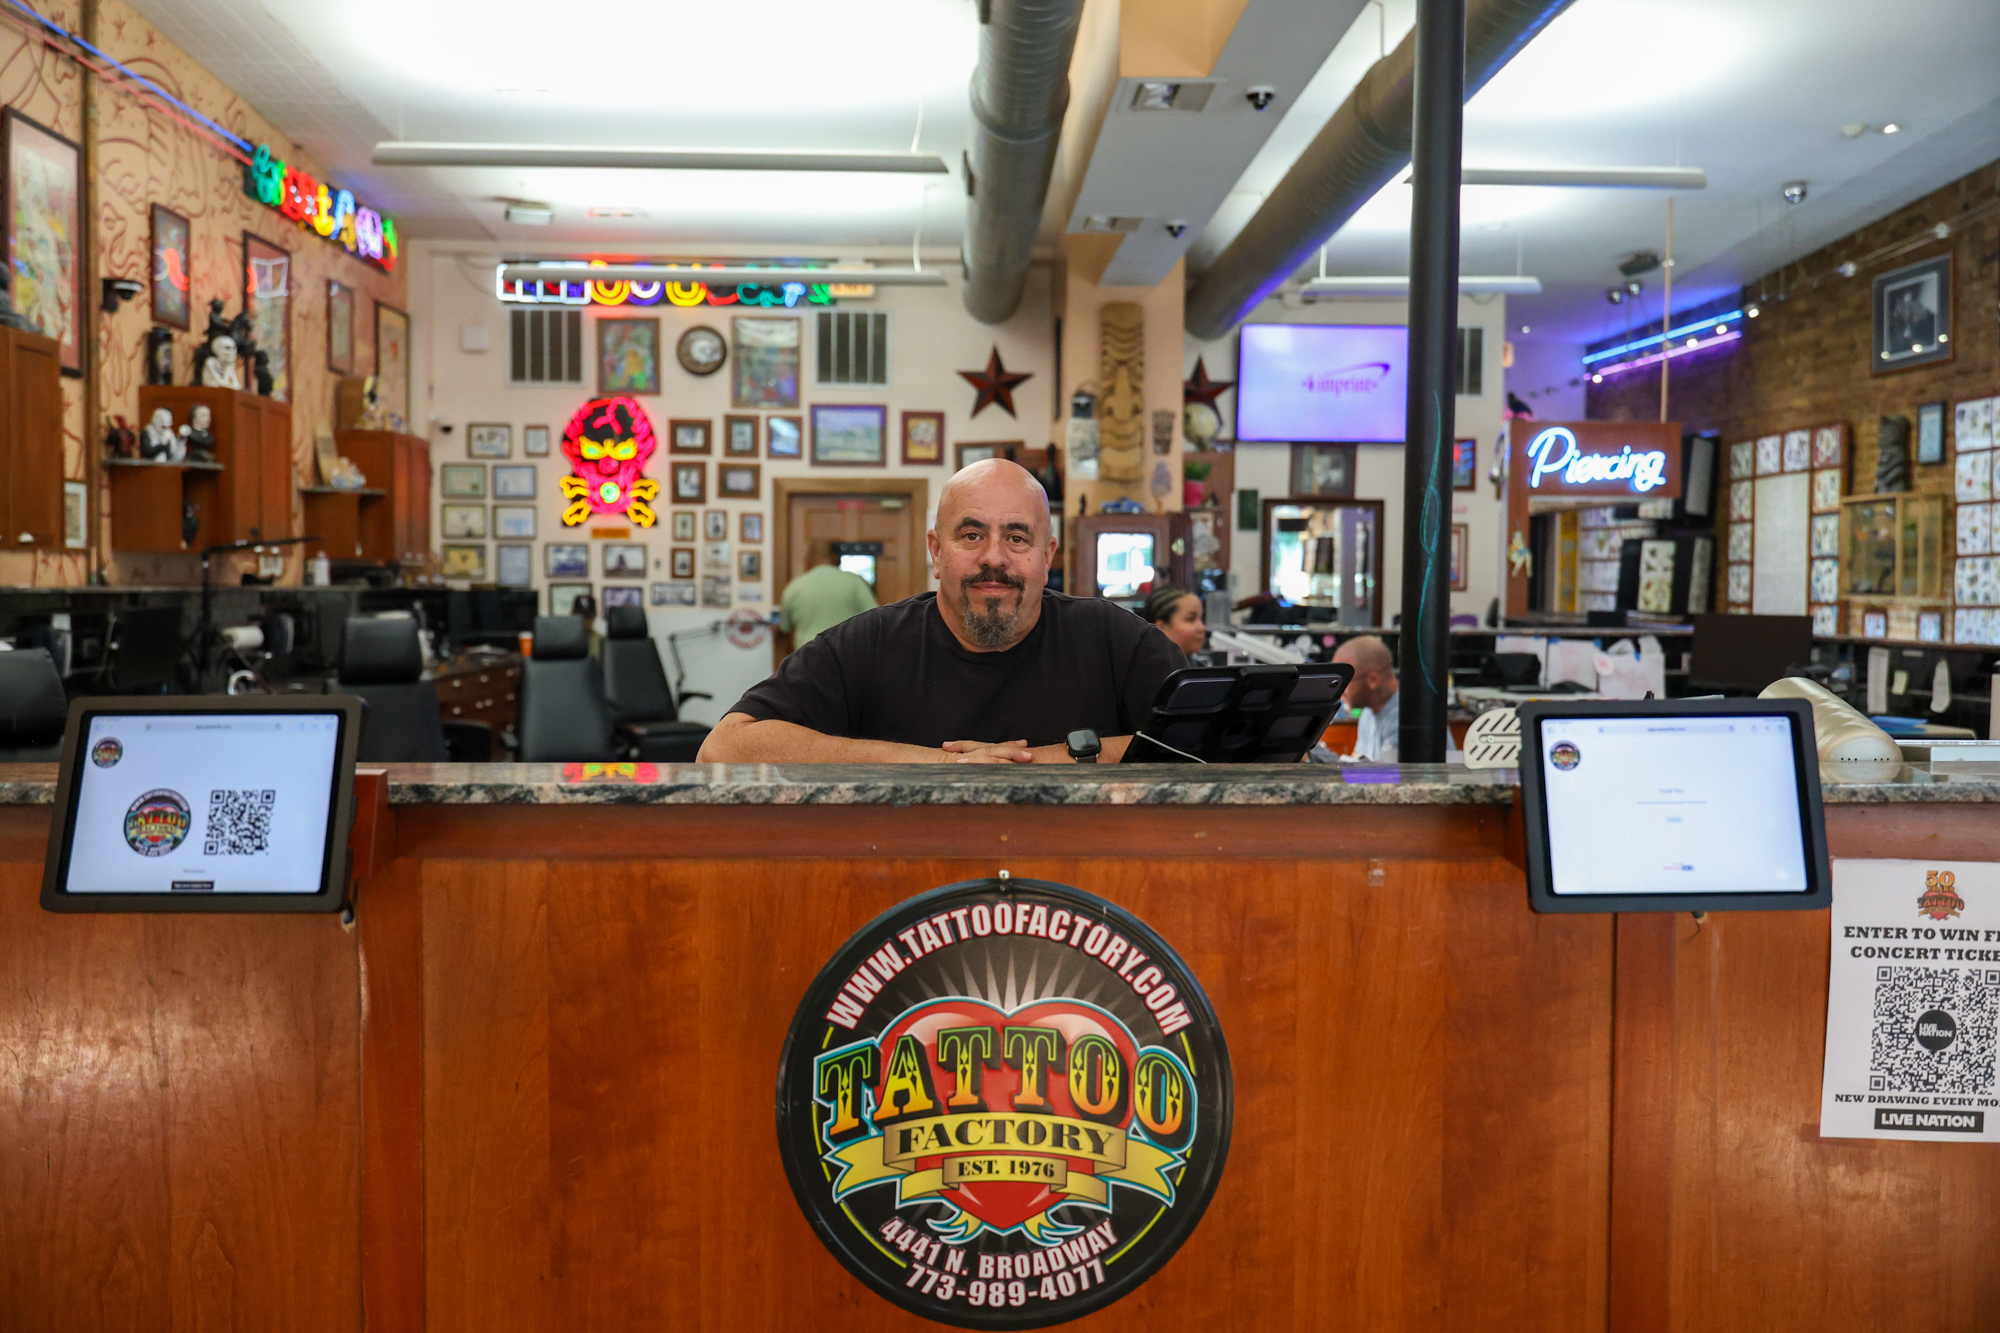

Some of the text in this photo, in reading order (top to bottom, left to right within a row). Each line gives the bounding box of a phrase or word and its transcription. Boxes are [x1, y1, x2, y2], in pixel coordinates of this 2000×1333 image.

[1527, 426, 1668, 492] Piercing
[1926, 870, 1955, 887] 50
[1844, 926, 1908, 939] ENTER
[1912, 928, 1936, 939] TO
[1939, 929, 1979, 942] WIN
[1850, 946, 1941, 959] CONCERT
[825, 901, 1194, 1036] WWW.TATTOOFACTORY.COM
[1919, 1029, 1953, 1037] NATION
[818, 1025, 1188, 1141] TATTOO
[1835, 1094, 1864, 1103] NEW
[1868, 1095, 1930, 1105] DRAWING
[1933, 1096, 1975, 1106] EVERY
[1881, 1112, 1976, 1128] LIVE NATION
[896, 1119, 1115, 1155] FACTORY
[957, 1159, 1056, 1179] EST. 1976
[879, 1216, 1120, 1279] 4441 N. BROADWAY
[905, 1259, 1106, 1308] 773-989-4077
